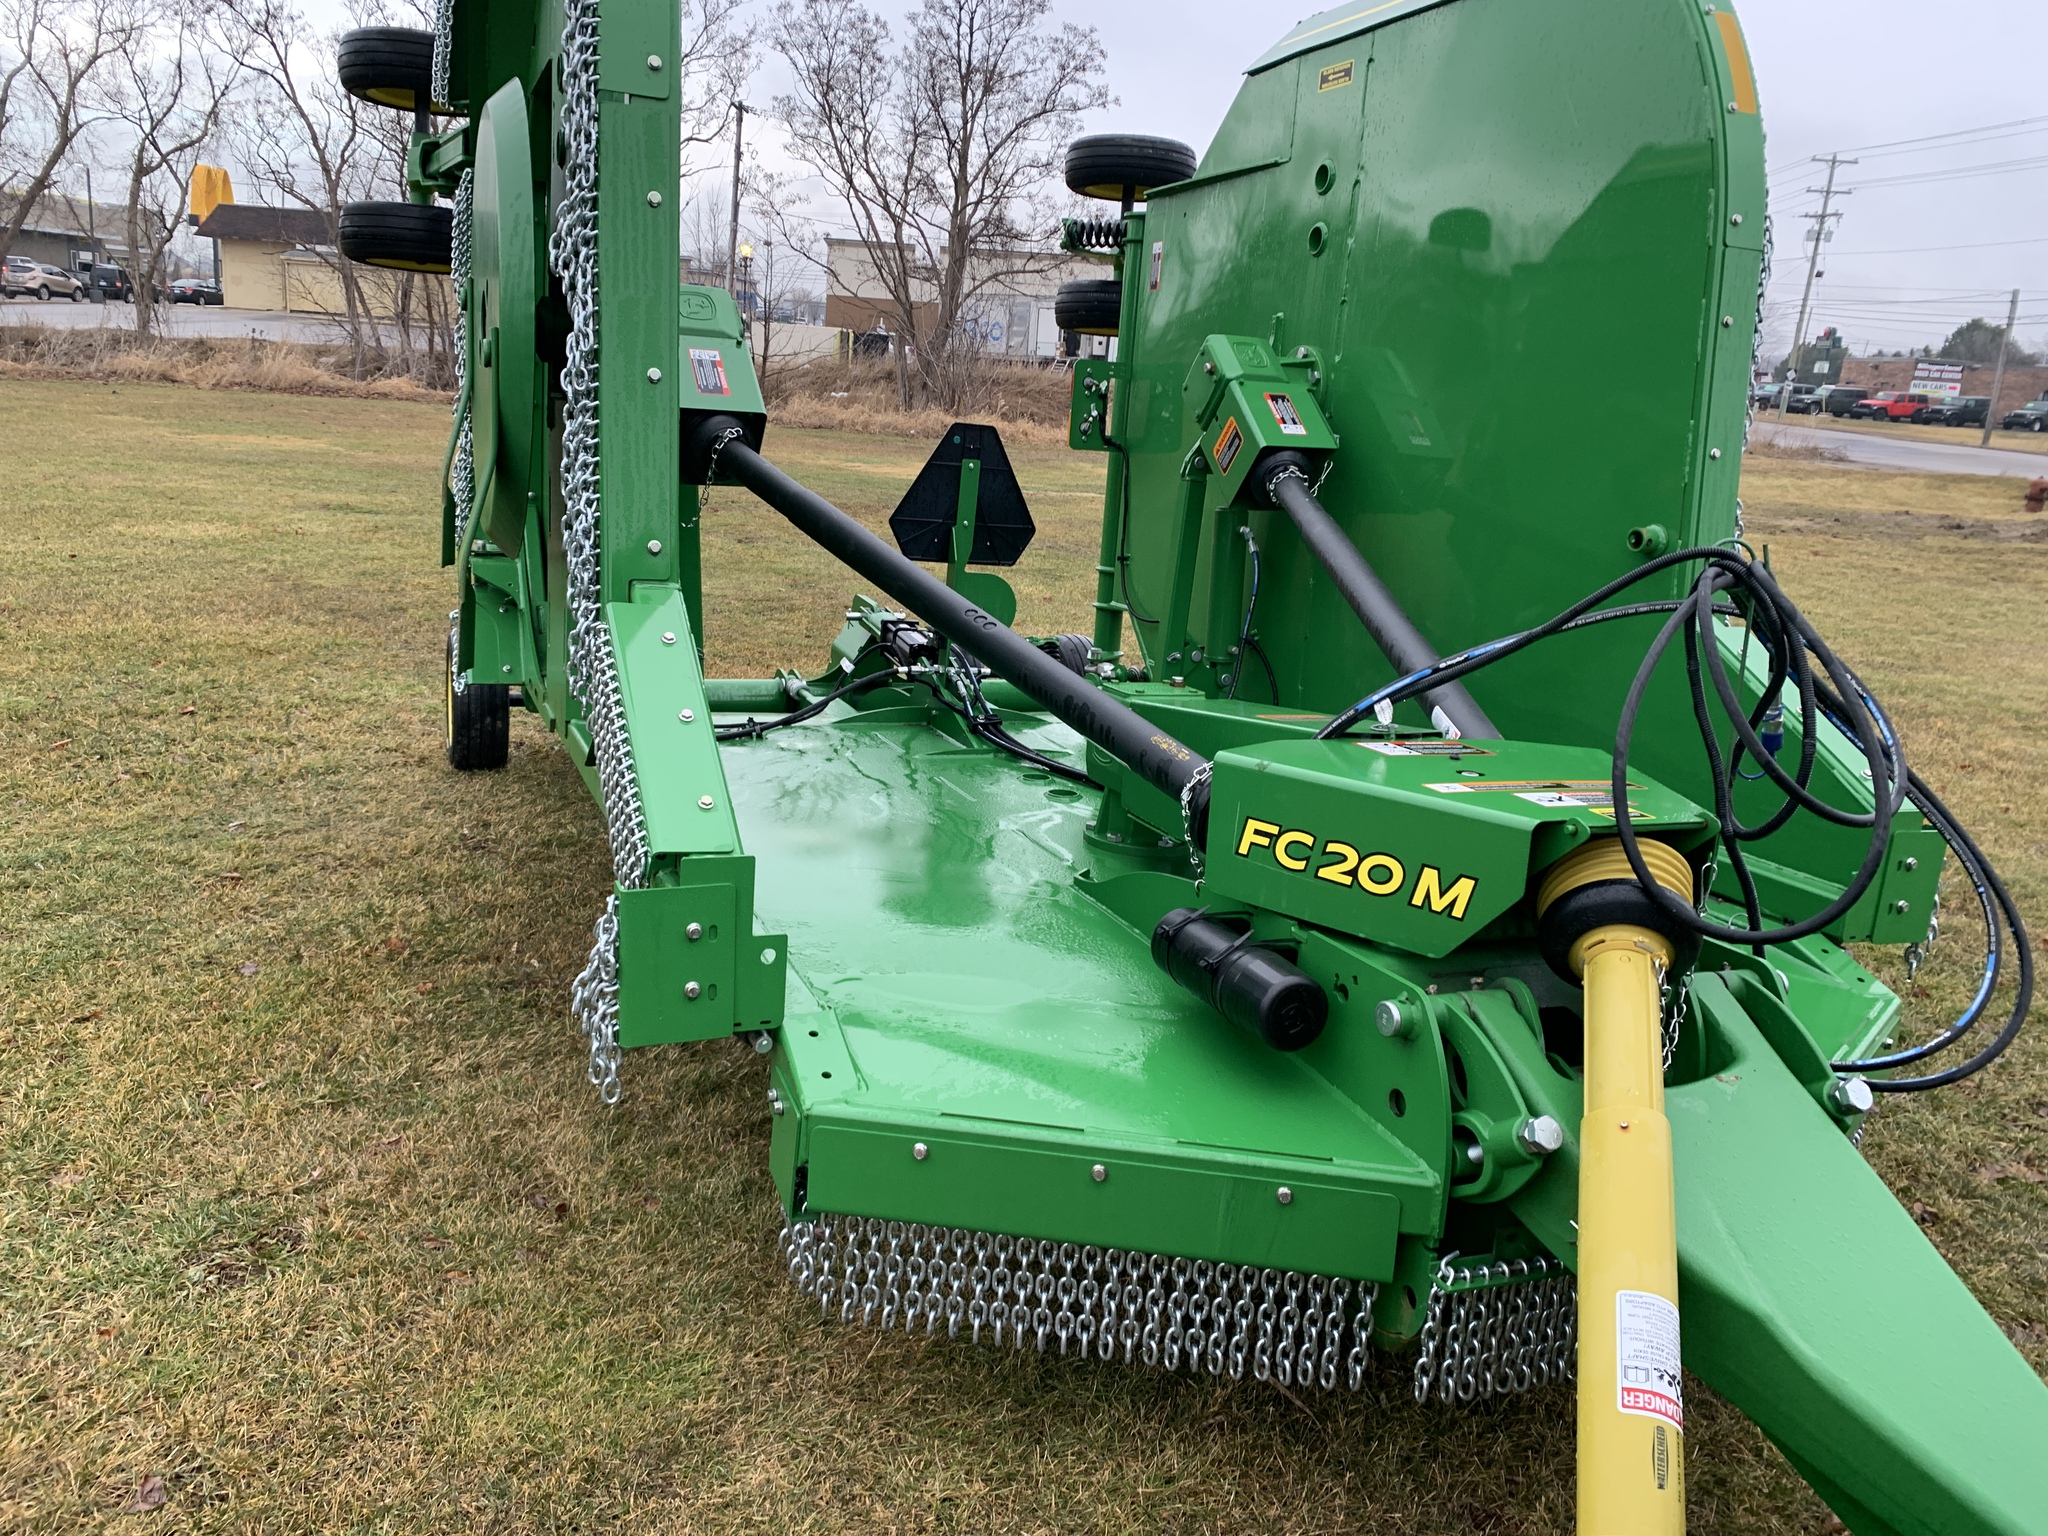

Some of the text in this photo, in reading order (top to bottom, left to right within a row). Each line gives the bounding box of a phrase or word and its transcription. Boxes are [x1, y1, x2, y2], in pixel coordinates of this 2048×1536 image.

[1235, 816, 1479, 922] FC 20 M
[1625, 1299, 1655, 1307] ADAPTORS
[1644, 1344, 1665, 1353] AWAY!
[1627, 1354, 1668, 1367] DRIVESHAFT
[1623, 1391, 1680, 1422] DANGER
[1656, 1426, 1666, 1490] WALTERSCHEID
